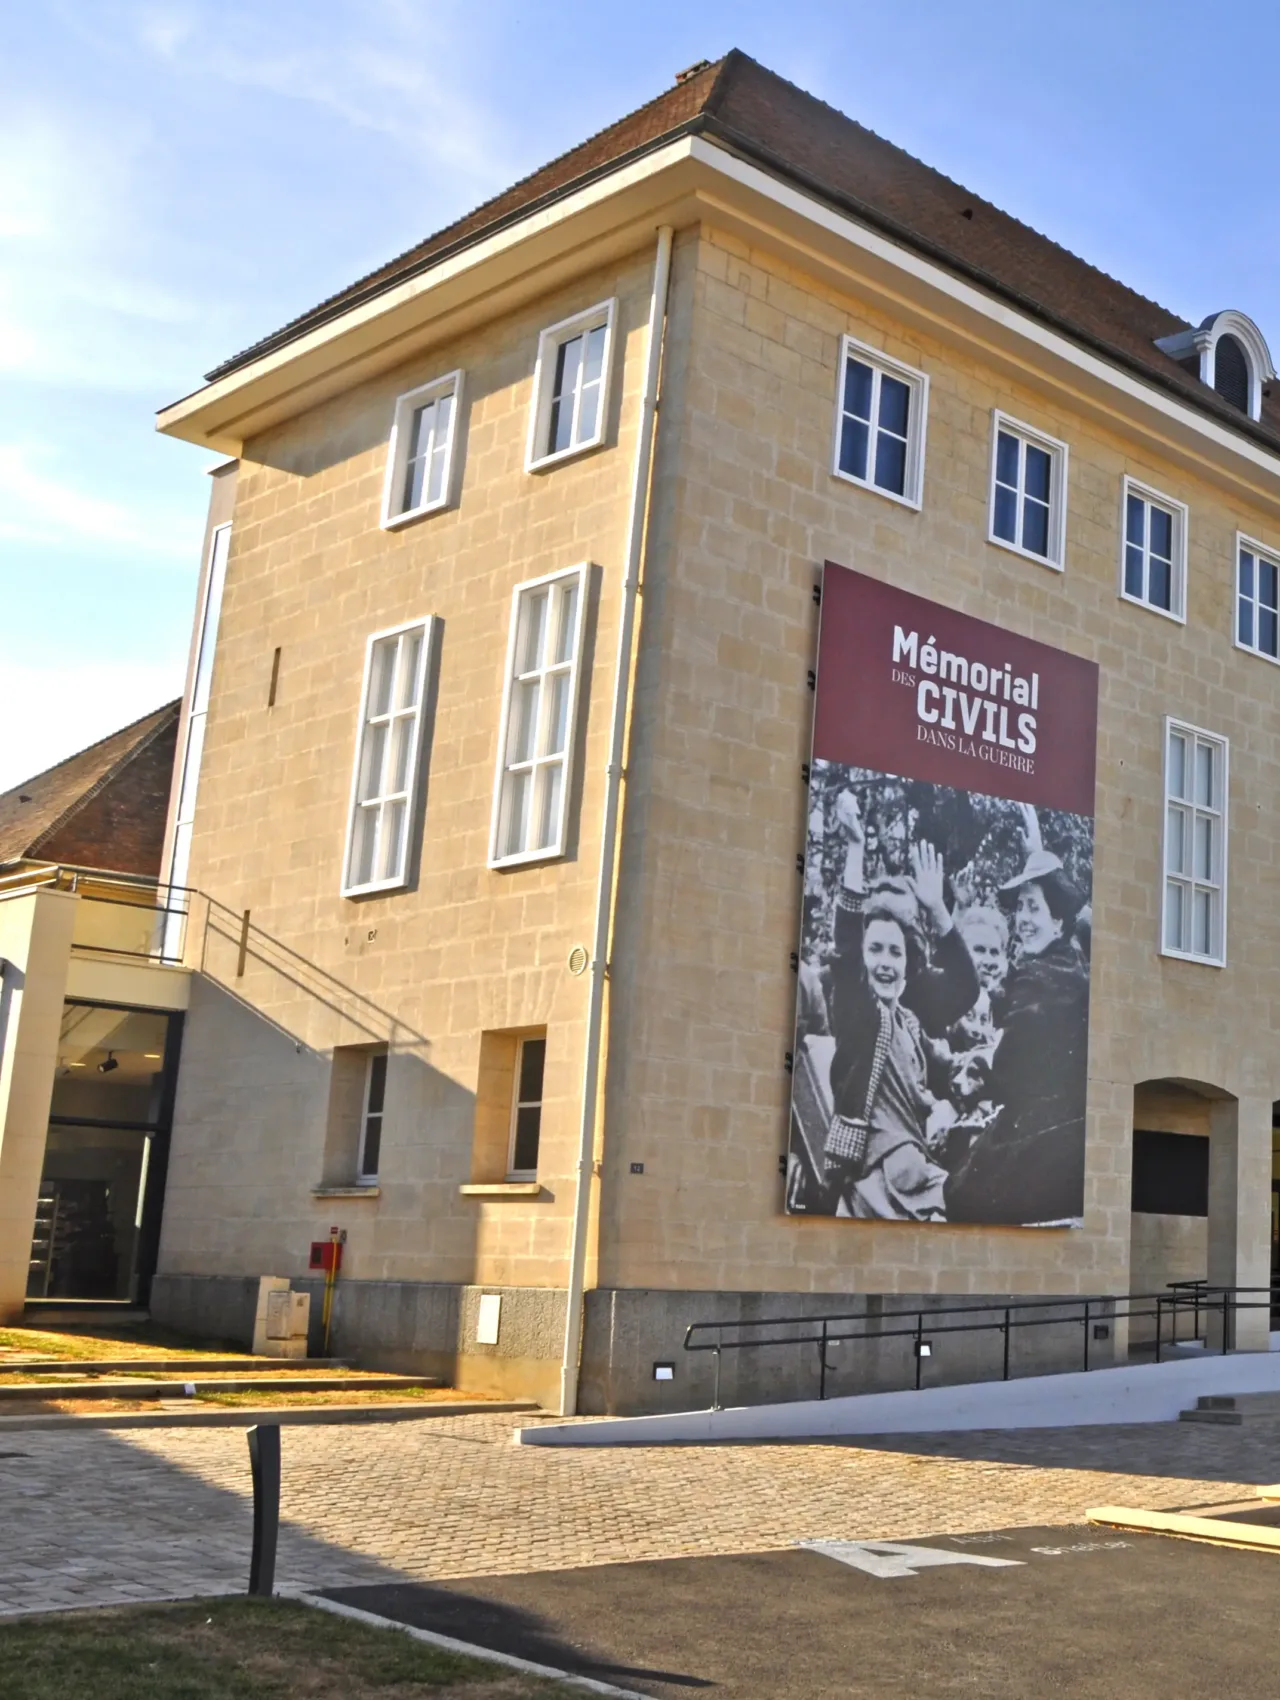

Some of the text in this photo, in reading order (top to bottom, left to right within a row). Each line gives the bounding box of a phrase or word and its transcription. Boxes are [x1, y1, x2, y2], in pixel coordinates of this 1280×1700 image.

[893, 626, 1039, 710] Mémorial
[892, 669, 1037, 754] DES CIVILS
[917, 725, 1035, 775] DANS LA GUERRE
